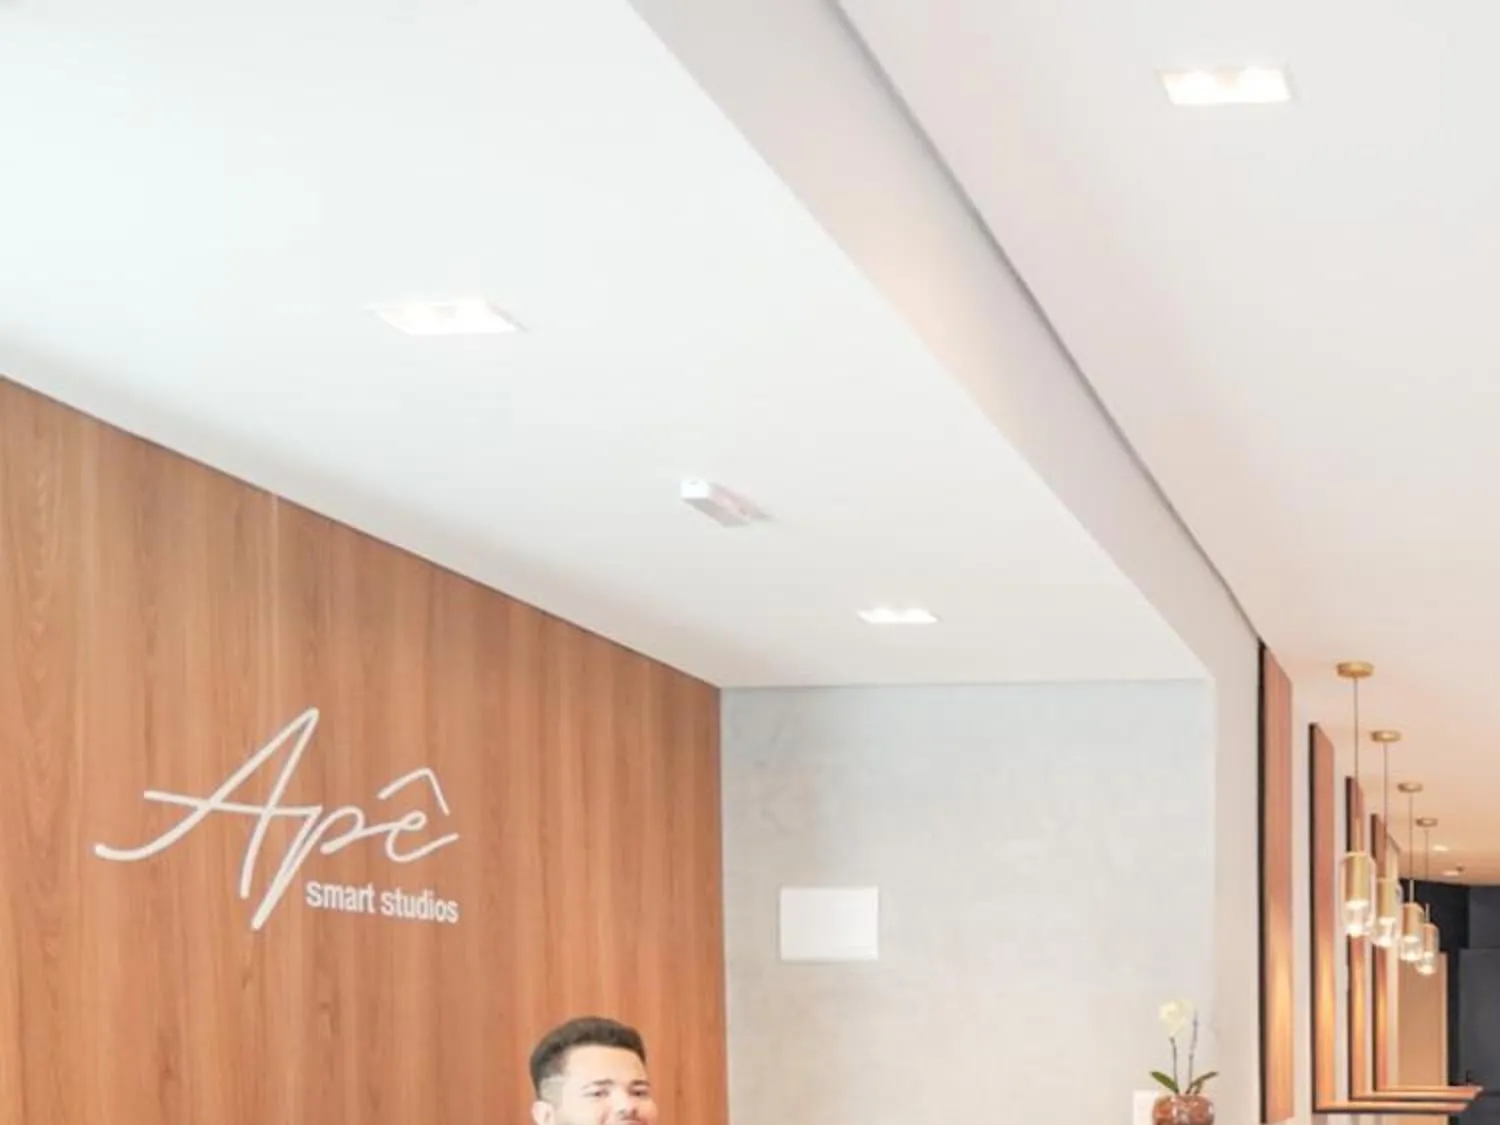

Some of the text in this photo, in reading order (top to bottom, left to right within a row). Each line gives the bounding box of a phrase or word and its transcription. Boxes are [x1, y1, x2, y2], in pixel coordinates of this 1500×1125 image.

[95, 707, 459, 930] Apê
[305, 880, 459, 924] smart studios
